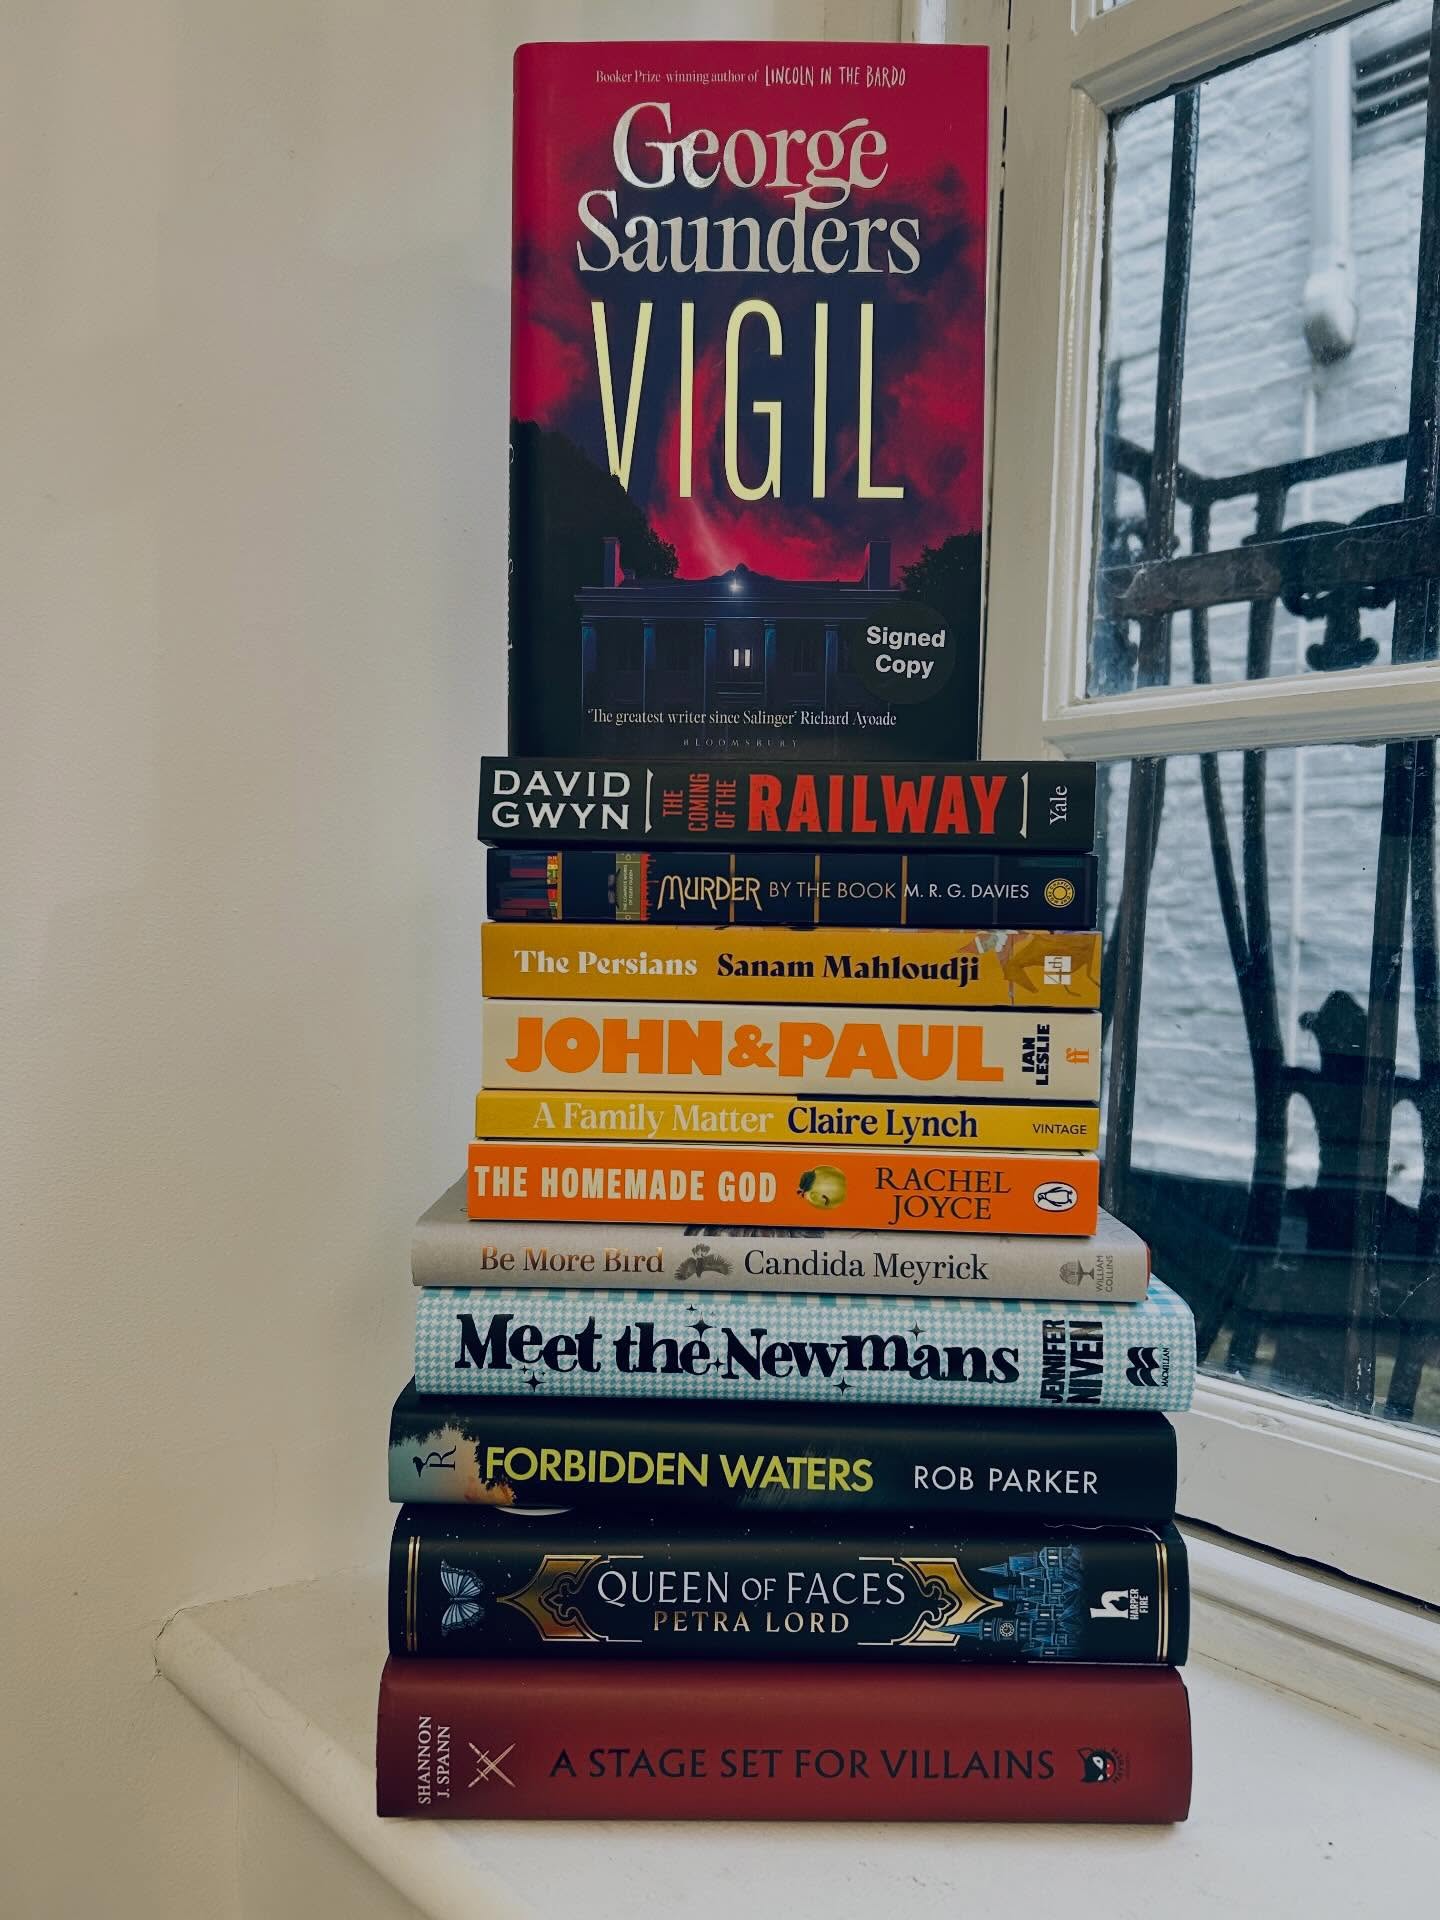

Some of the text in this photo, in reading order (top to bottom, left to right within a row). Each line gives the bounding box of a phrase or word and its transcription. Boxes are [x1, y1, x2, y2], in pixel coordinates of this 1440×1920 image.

[595, 69, 633, 83] Booker
[711, 69, 746, 83] author
[747, 69, 760, 83] of
[765, 65, 814, 88] LINCOLN
[820, 66, 832, 85] IN
[838, 66, 861, 85] THE
[866, 65, 906, 88] BARDO
[613, 102, 889, 204] George
[576, 190, 921, 274] Saunders
[591, 299, 905, 501] VIGIL
[866, 625, 946, 650] Signed
[875, 654, 935, 679] Copy
[615, 710, 664, 726] greatest
[667, 710, 707, 724] writer
[709, 710, 740, 724] since
[800, 711, 849, 726] Richard
[852, 711, 897, 728] Ayoade
[492, 769, 631, 798] DAVID
[491, 801, 630, 830] GWYN
[662, 790, 683, 817] THE
[688, 773, 710, 832] COMING
[715, 779, 737, 829] OF THE
[748, 774, 1008, 834] RAILWAY
[1049, 785, 1067, 825] Yale
[657, 874, 897, 911] MURDER BY THE BOOK
[903, 883, 1030, 899] M. R. G. DAVIES
[513, 950, 698, 977] The Persians
[717, 952, 980, 988] Sanam Mahloudji
[1022, 1037, 1035, 1073] IAN
[1036, 1024, 1050, 1085] LESLIE
[532, 1102, 774, 1139] A Family Matter
[788, 1106, 978, 1144] Claire Lynch
[1032, 1123, 1088, 1136] VINTAGE
[474, 1165, 777, 1203] THE HOMEMADE GOD
[874, 1167, 1011, 1194] RACHEL
[888, 1194, 992, 1226] JOYCE
[480, 1246, 665, 1273] Be More Bird
[744, 1249, 990, 1286] Candida Meyrick
[1096, 1255, 1105, 1292] WILLIAM
[1105, 1255, 1113, 1293] COLLINS
[454, 1313, 1020, 1385] Meet the Newmans
[1040, 1319, 1066, 1403] JENNIFER
[1066, 1321, 1104, 1403] NIVEN
[1160, 1346, 1170, 1388] MACMILLAN
[486, 1445, 874, 1493] FORBIDDEN WATERS
[914, 1464, 1099, 1495] ROB PARKER
[598, 1570, 906, 1607] QUEEN OF FACES
[1129, 1588, 1140, 1620] HARPER
[1139, 1595, 1149, 1614] FIRE
[653, 1610, 850, 1634] PETRA LORD
[417, 1715, 432, 1805] SHANNON
[436, 1725, 451, 1799] J. SPANN
[549, 1748, 1056, 1780] A STAGE SET FOR VILLAINS
